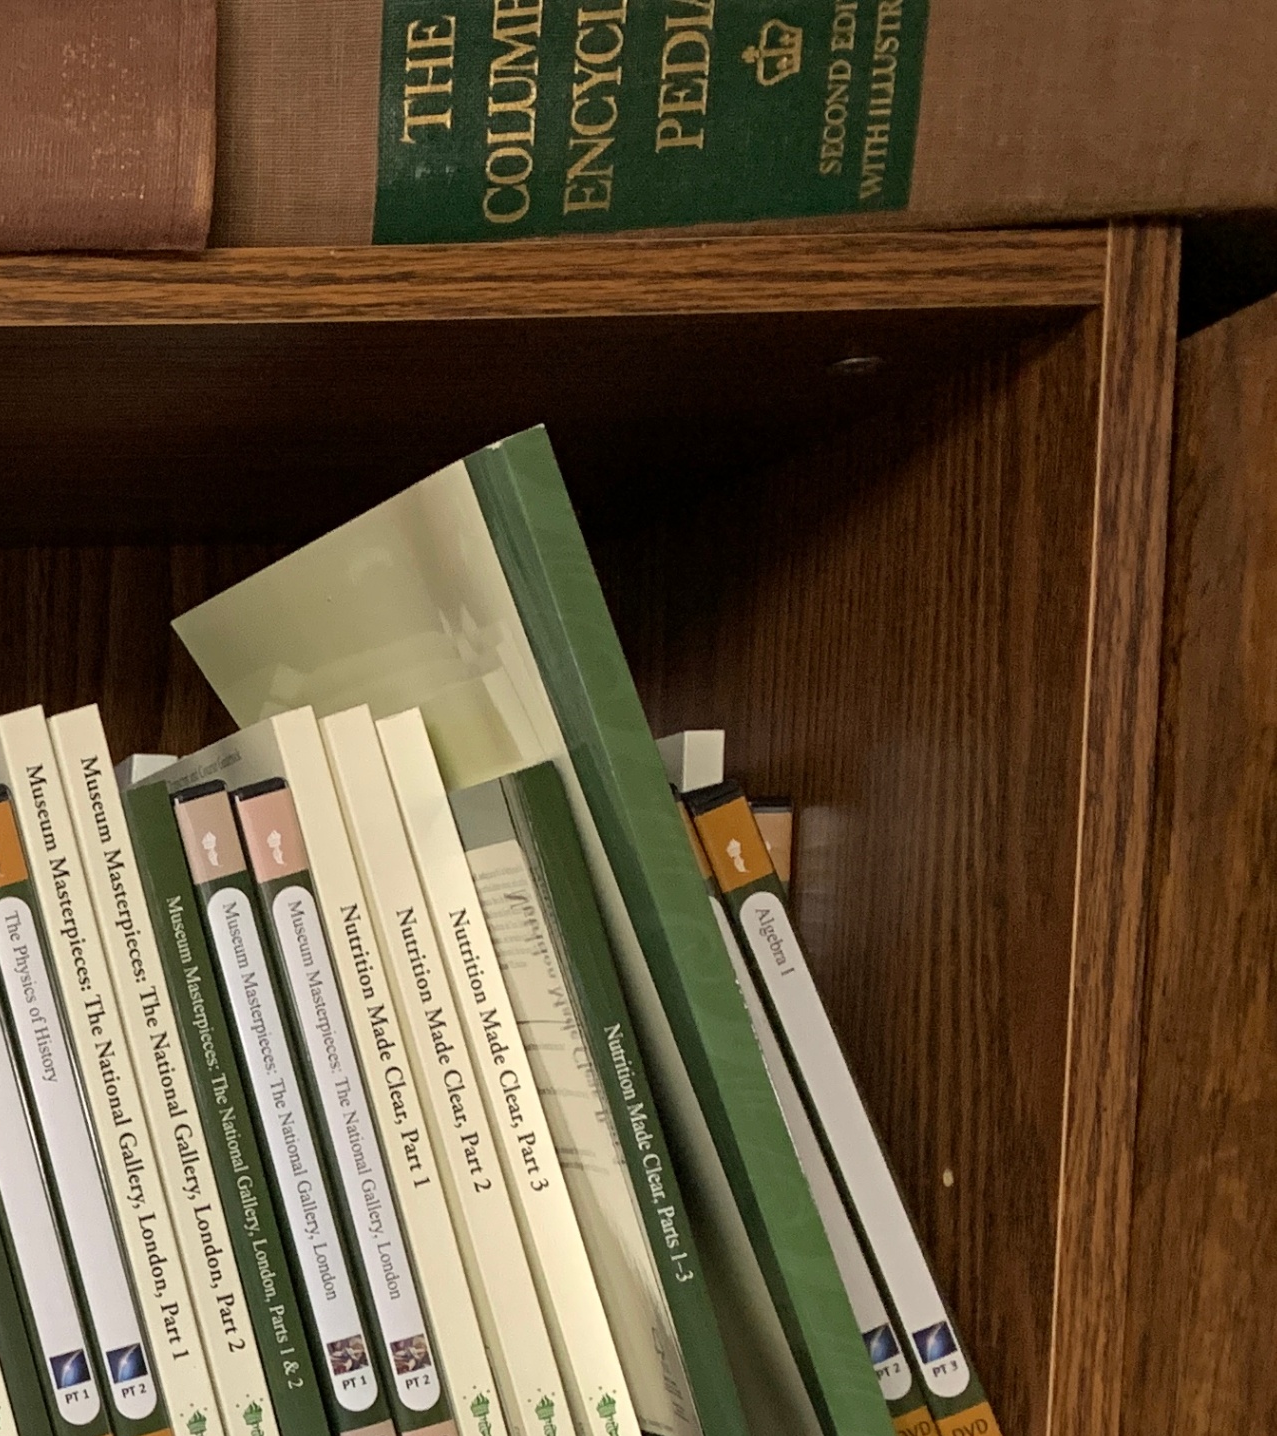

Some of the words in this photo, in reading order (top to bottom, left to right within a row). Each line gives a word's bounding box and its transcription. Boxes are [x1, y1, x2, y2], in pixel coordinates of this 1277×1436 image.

[399, 15, 456, 144] THE
[655, 0, 716, 154] PEDI
[819, 59, 852, 175] SECOND
[858, 122, 891, 200] WITH
[25, 763, 58, 854] Museum
[48, 855, 93, 993] Masterpieces:
[754, 907, 788, 968] Algebra
[779, 966, 796, 978] I
[83, 992, 107, 1037] The
[447, 906, 488, 1006] Nutrition
[478, 1007, 511, 1067] Made
[498, 1068, 525, 1130] Clear,
[515, 1130, 540, 1176] Part
[529, 1177, 551, 1193] 3
[93, 1038, 134, 1128] National
[117, 1131, 147, 1210] Gallery,
[137, 1211, 169, 1299] London,
[159, 1301, 183, 1346] Part
[171, 1348, 191, 1361] 1
